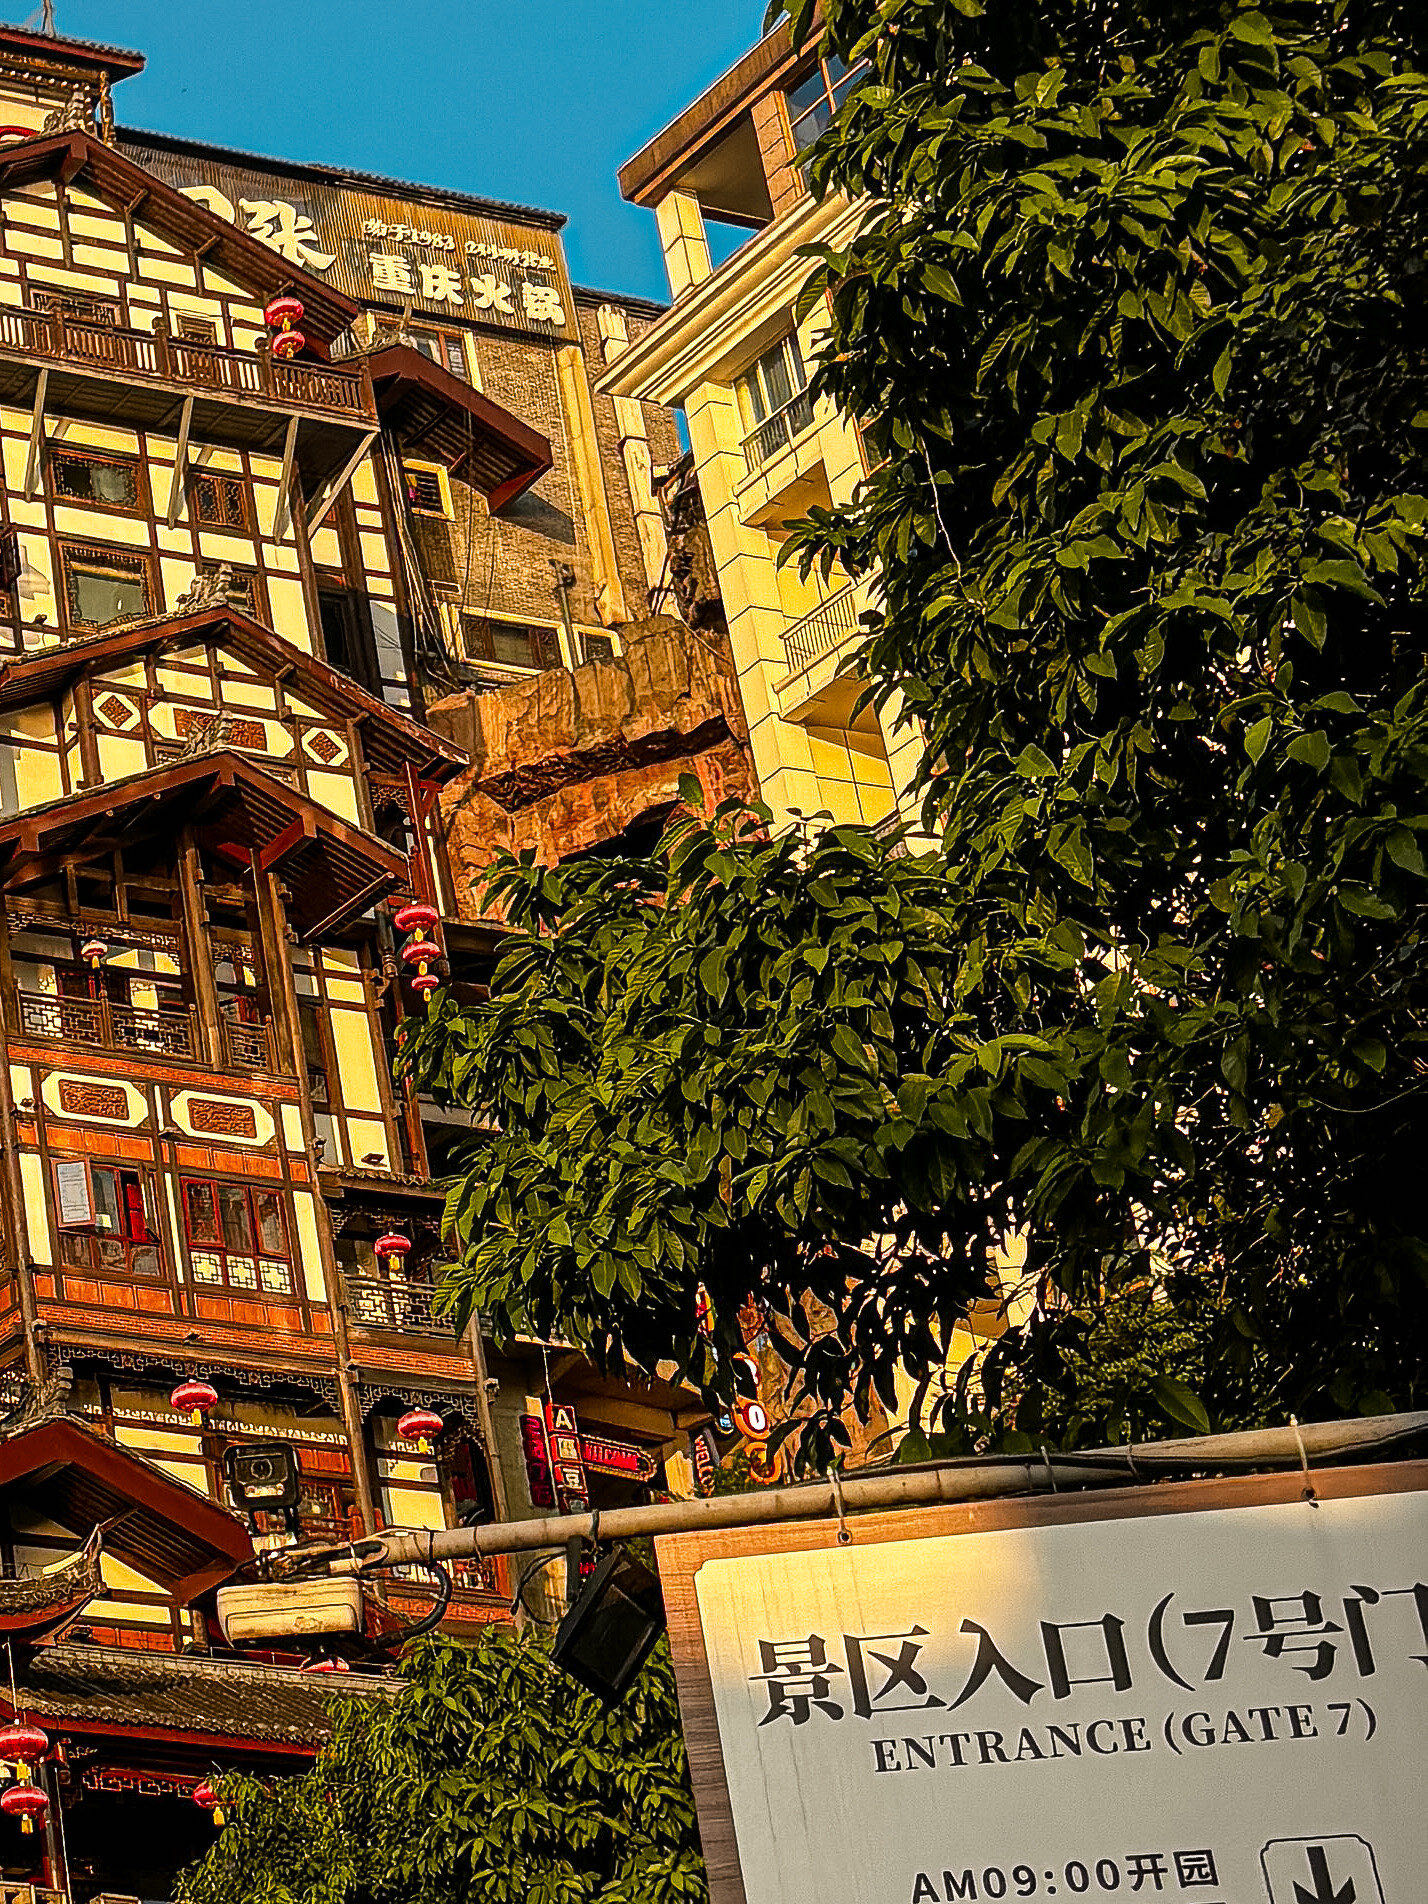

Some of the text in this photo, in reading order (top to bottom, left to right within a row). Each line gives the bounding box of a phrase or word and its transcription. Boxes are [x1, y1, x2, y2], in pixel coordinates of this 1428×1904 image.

[369, 252, 567, 326] 重庆火锅
[748, 1582, 1428, 1728] 景区入口(7号门
[871, 1697, 1378, 1775] ENTRANCE (GATE 7)
